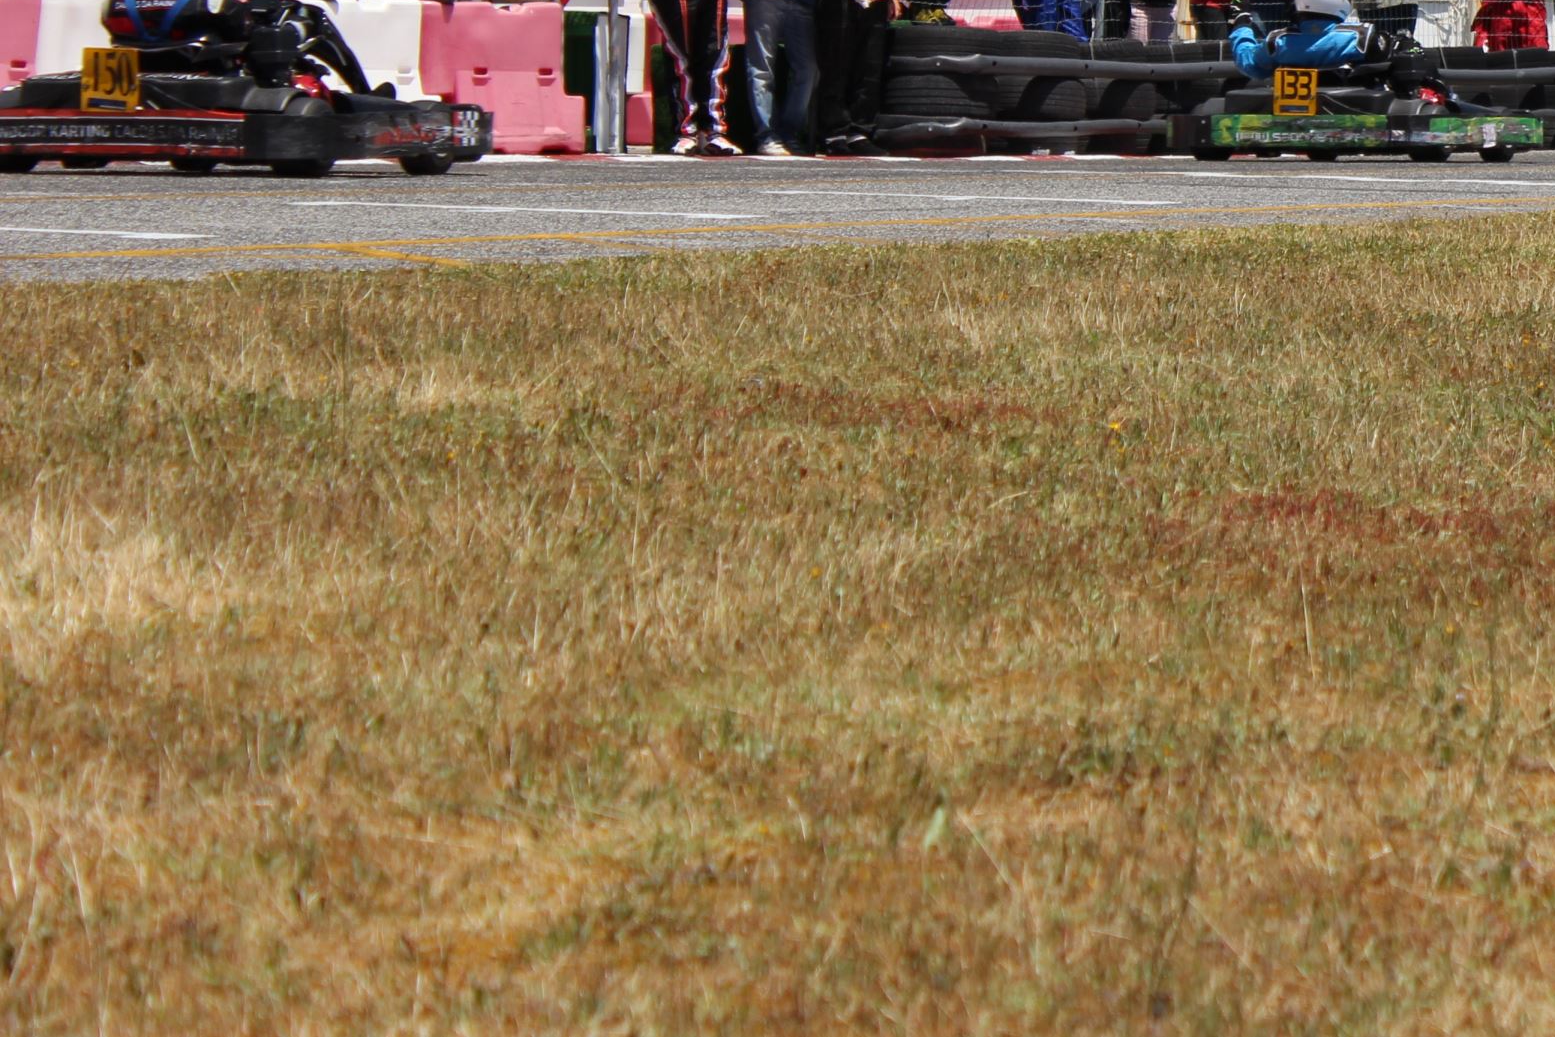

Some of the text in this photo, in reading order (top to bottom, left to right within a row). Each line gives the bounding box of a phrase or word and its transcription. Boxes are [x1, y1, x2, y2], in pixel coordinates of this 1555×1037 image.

[92, 51, 132, 98] 150
[1280, 71, 1313, 101] 133
[49, 124, 112, 138] KARTING
